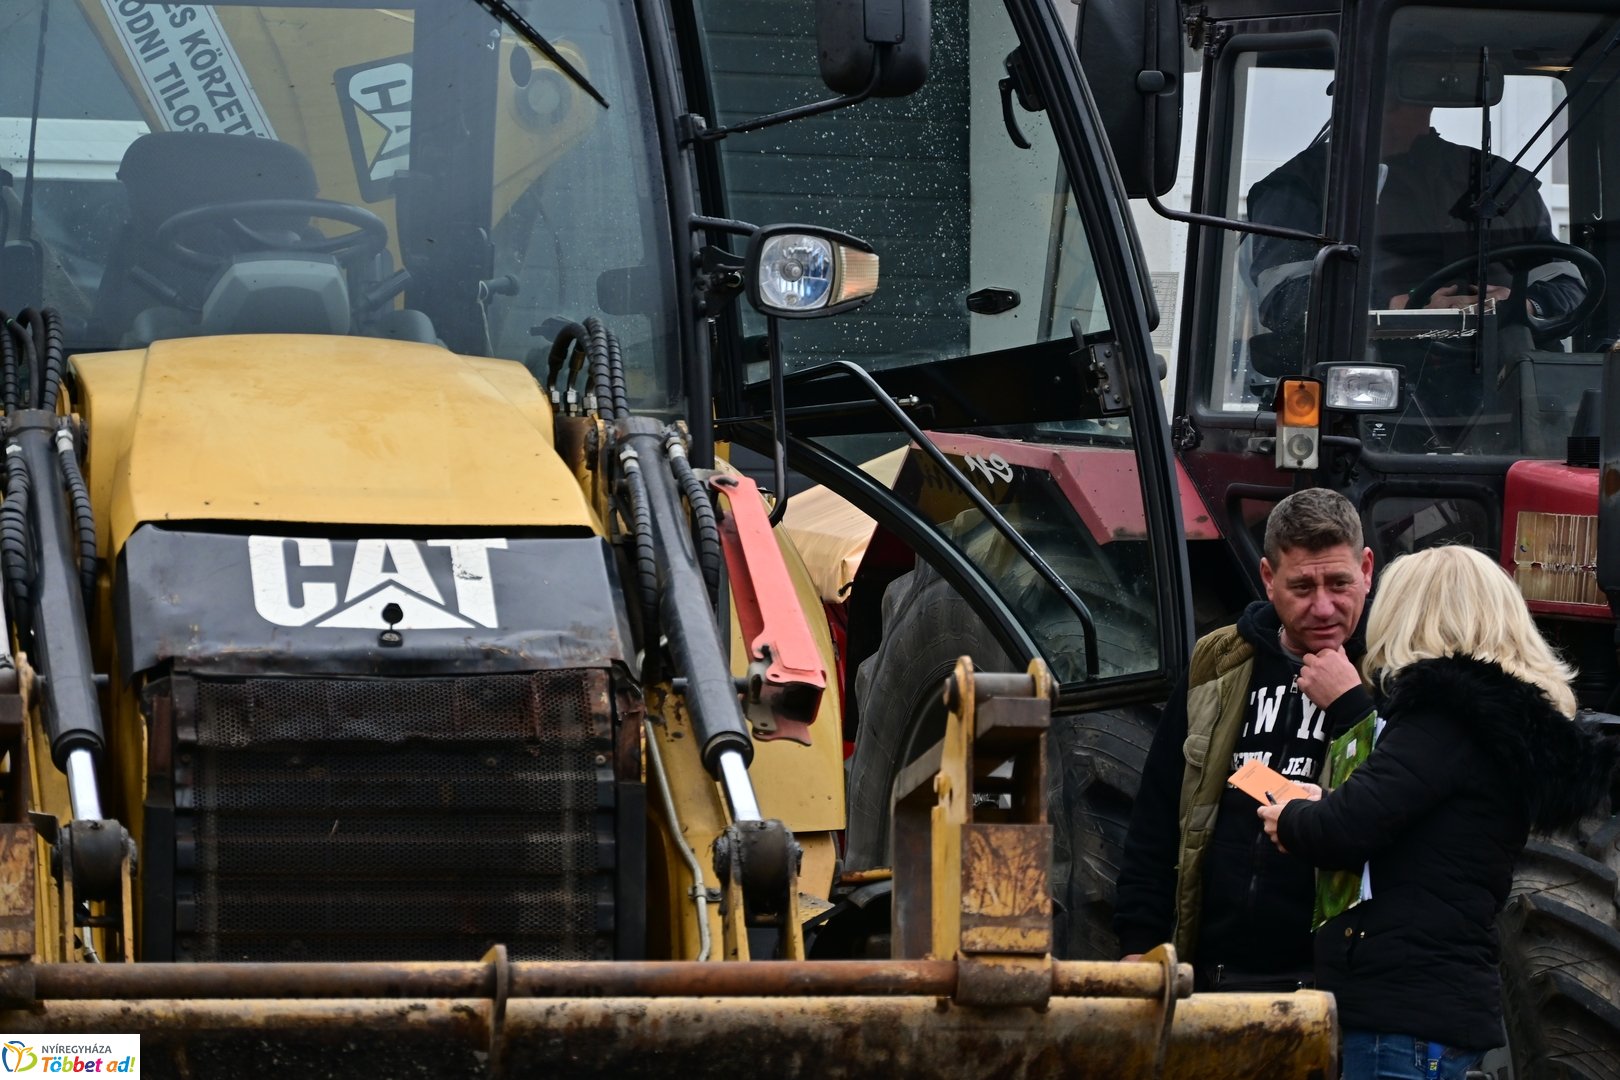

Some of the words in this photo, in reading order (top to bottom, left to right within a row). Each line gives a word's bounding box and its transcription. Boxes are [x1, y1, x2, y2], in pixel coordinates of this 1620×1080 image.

[114, 0, 170, 64] ODNI
[179, 28, 265, 138] KÖRZET
[248, 534, 508, 630] CAT
[1243, 685, 1287, 738] W
[1281, 757, 1317, 778] JEA
